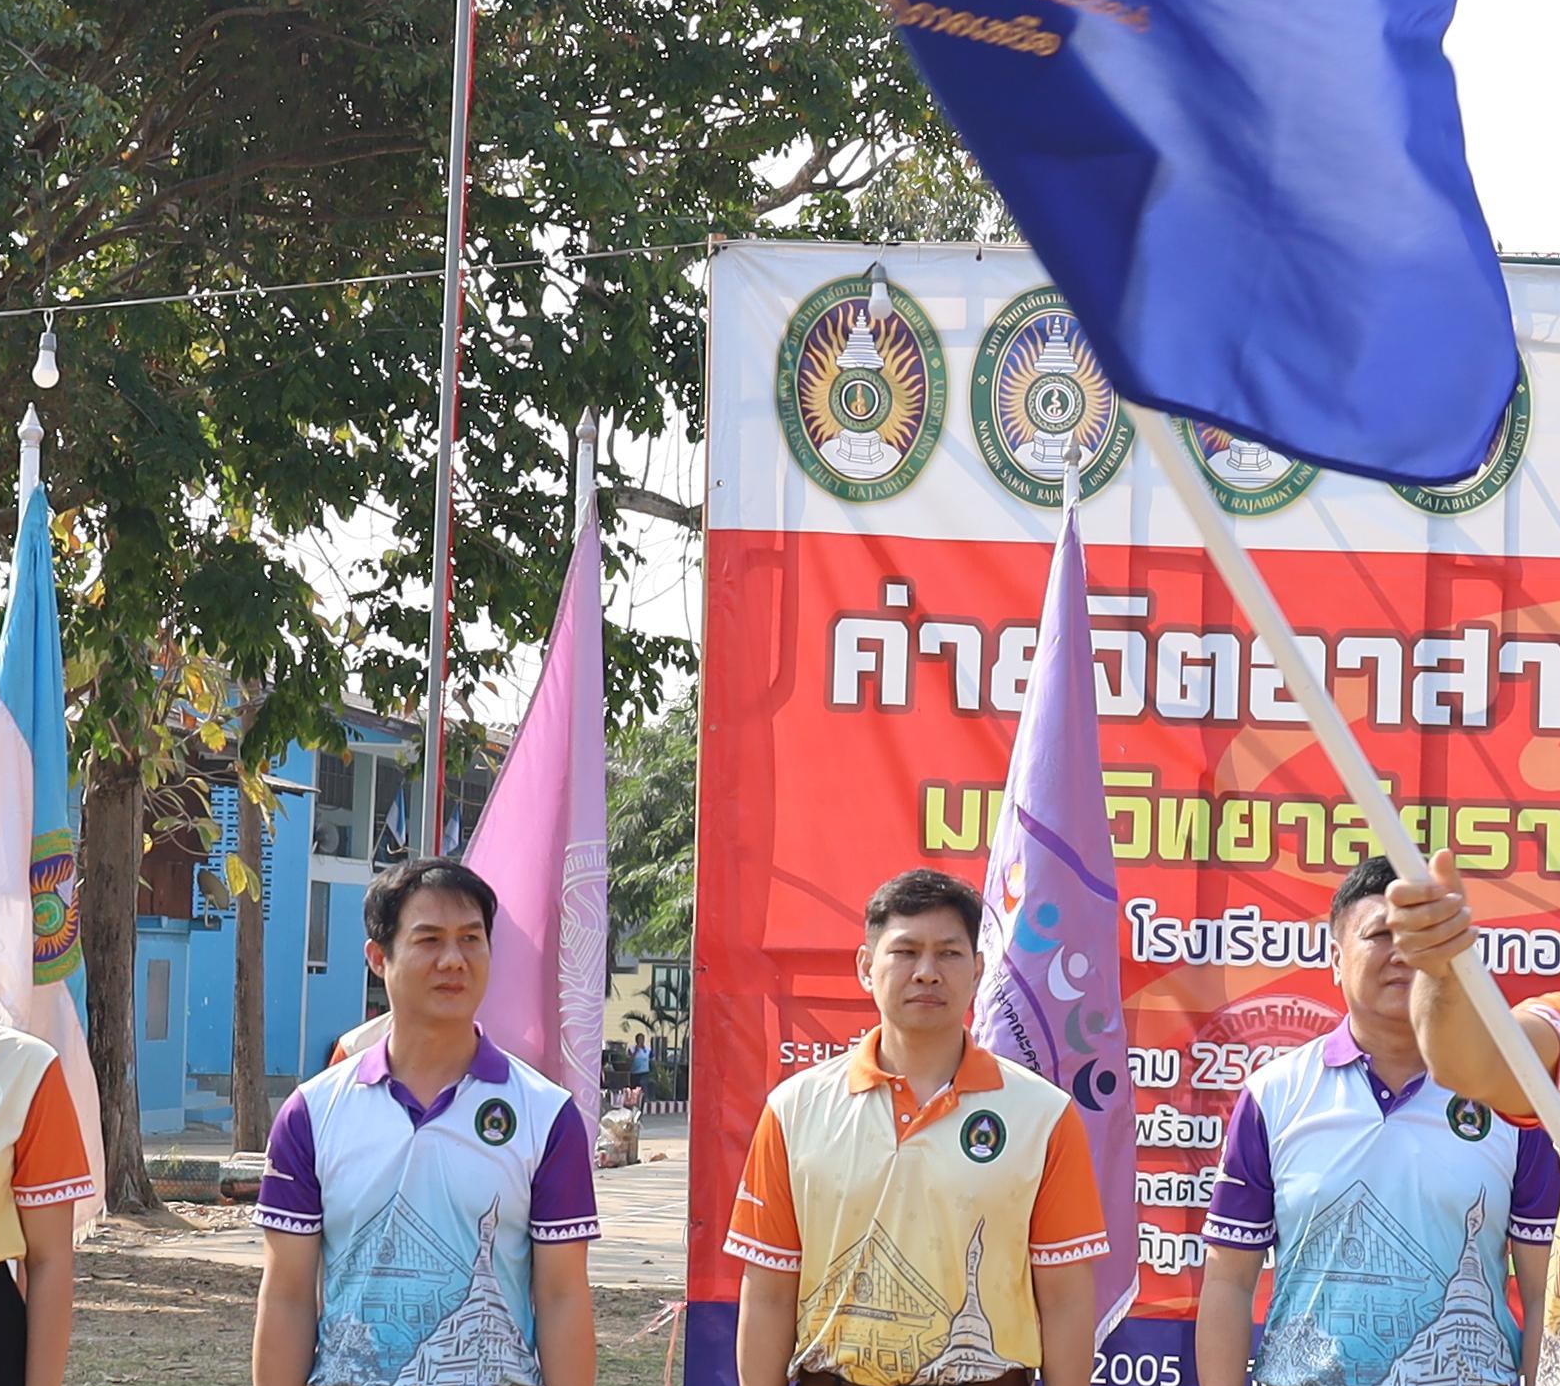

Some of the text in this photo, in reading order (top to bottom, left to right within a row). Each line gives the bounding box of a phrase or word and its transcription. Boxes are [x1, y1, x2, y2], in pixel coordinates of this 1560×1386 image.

[810, 463, 841, 493] PHET
[848, 465, 916, 499] RAJABHAT
[915, 377, 945, 461] UNIVERSITY
[1001, 469, 1032, 497] SAWAN
[1089, 423, 1129, 486] UNIVERSITY
[1414, 412, 1528, 511] RAJABHAT UNIVERSITY
[1231, 485, 1294, 512] RAJABHAT
